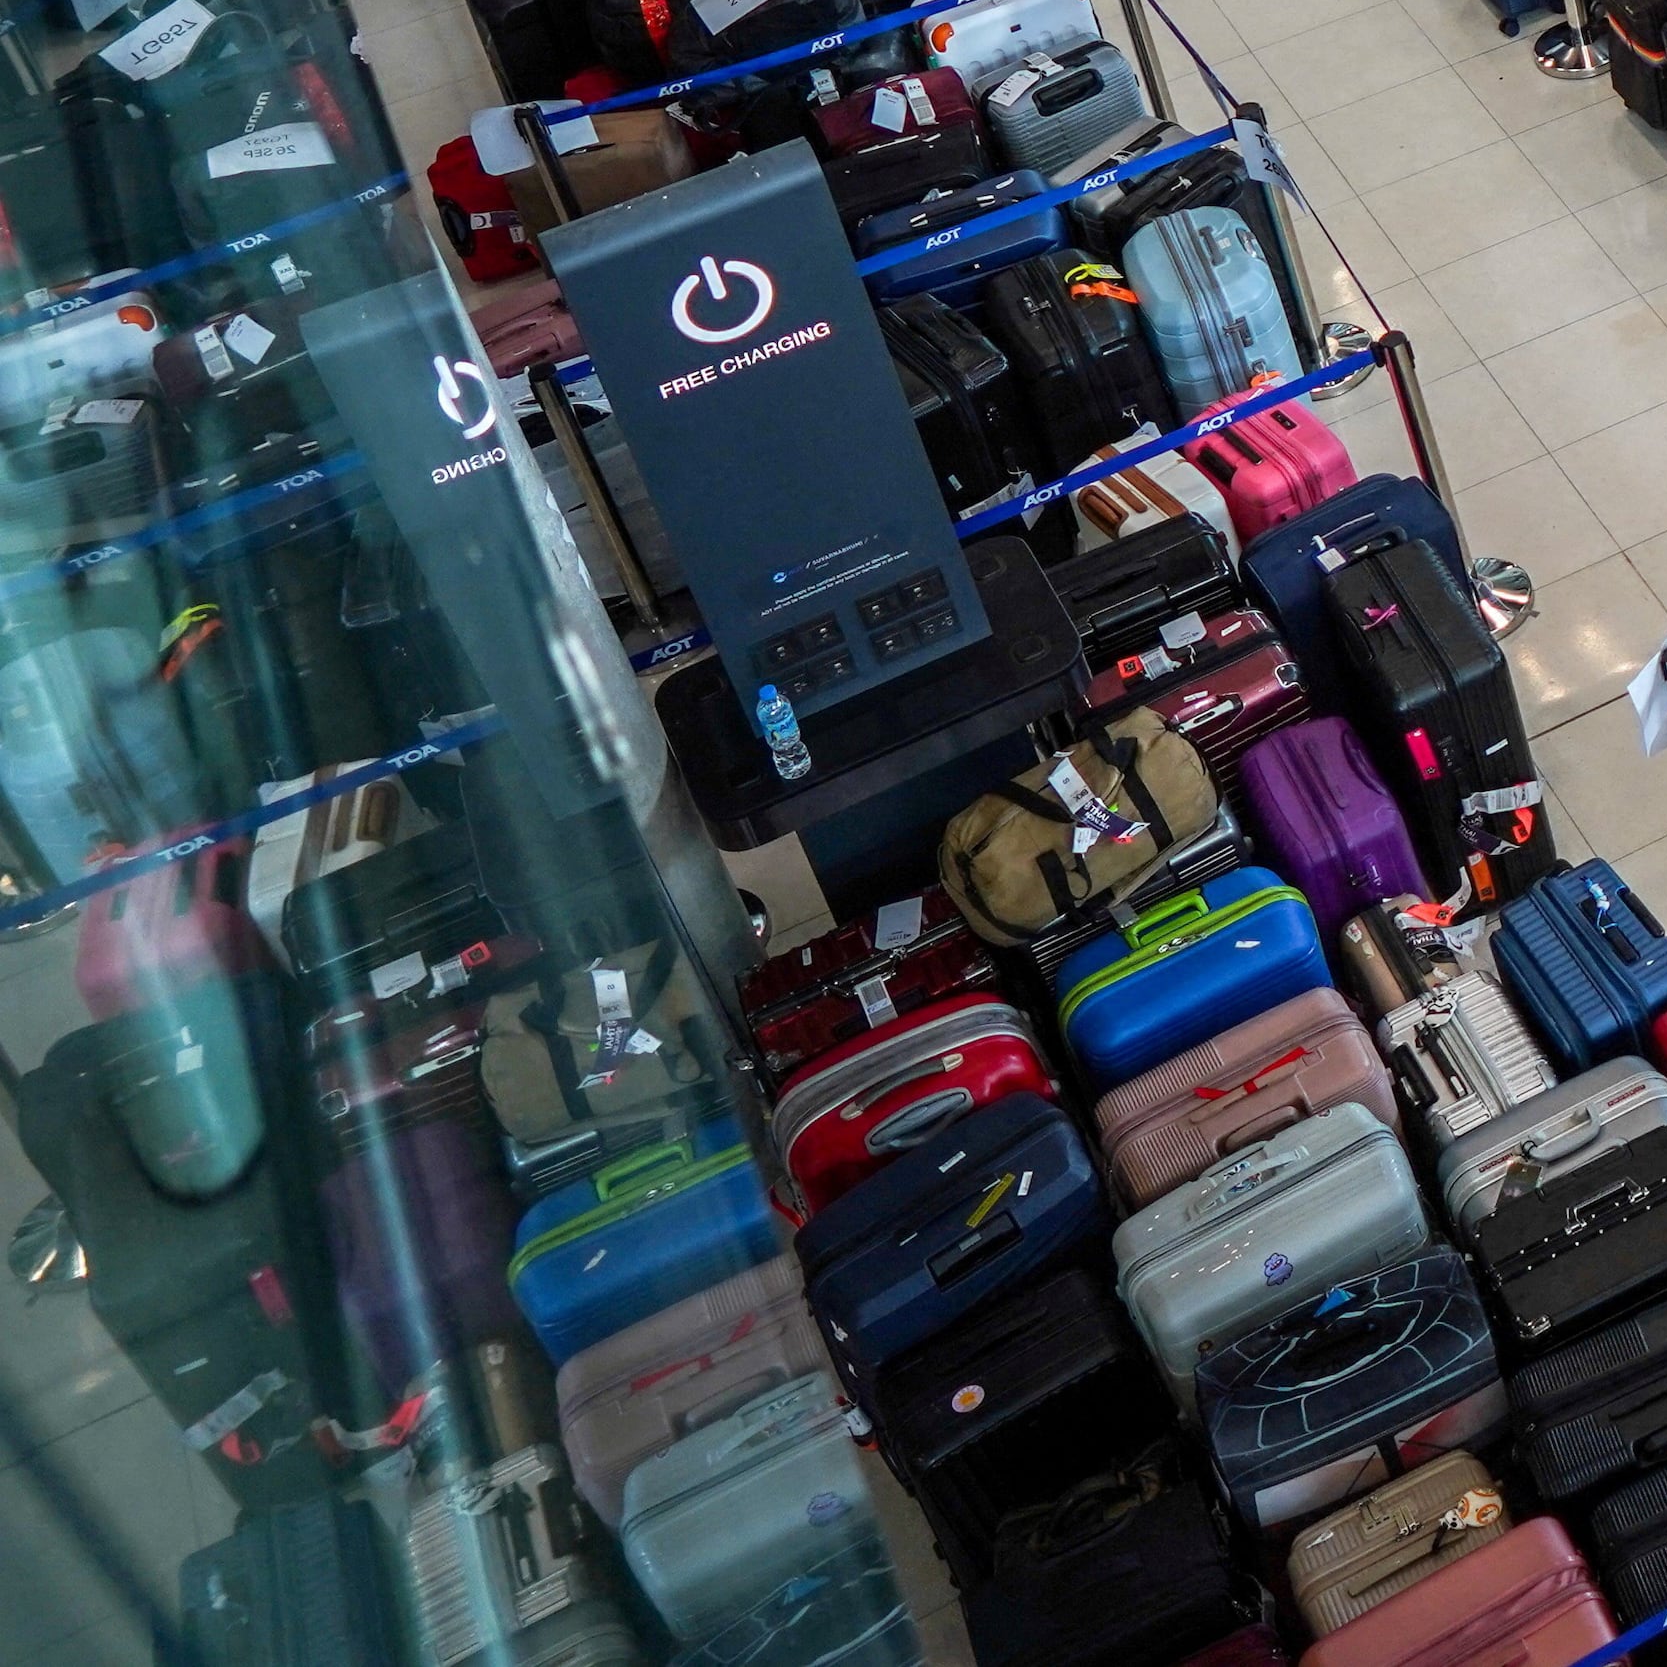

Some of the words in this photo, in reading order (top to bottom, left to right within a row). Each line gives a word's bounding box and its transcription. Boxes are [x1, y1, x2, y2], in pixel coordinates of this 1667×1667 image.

[659, 79, 692, 97] AOT
[1083, 171, 1117, 191] AOT
[659, 366, 718, 399] FREE
[719, 323, 831, 375] CHARGING
[1197, 411, 1234, 434] AOT
[652, 636, 693, 662] AOT
[1074, 789, 1088, 802] BKK
[1091, 804, 1110, 822] THAI
